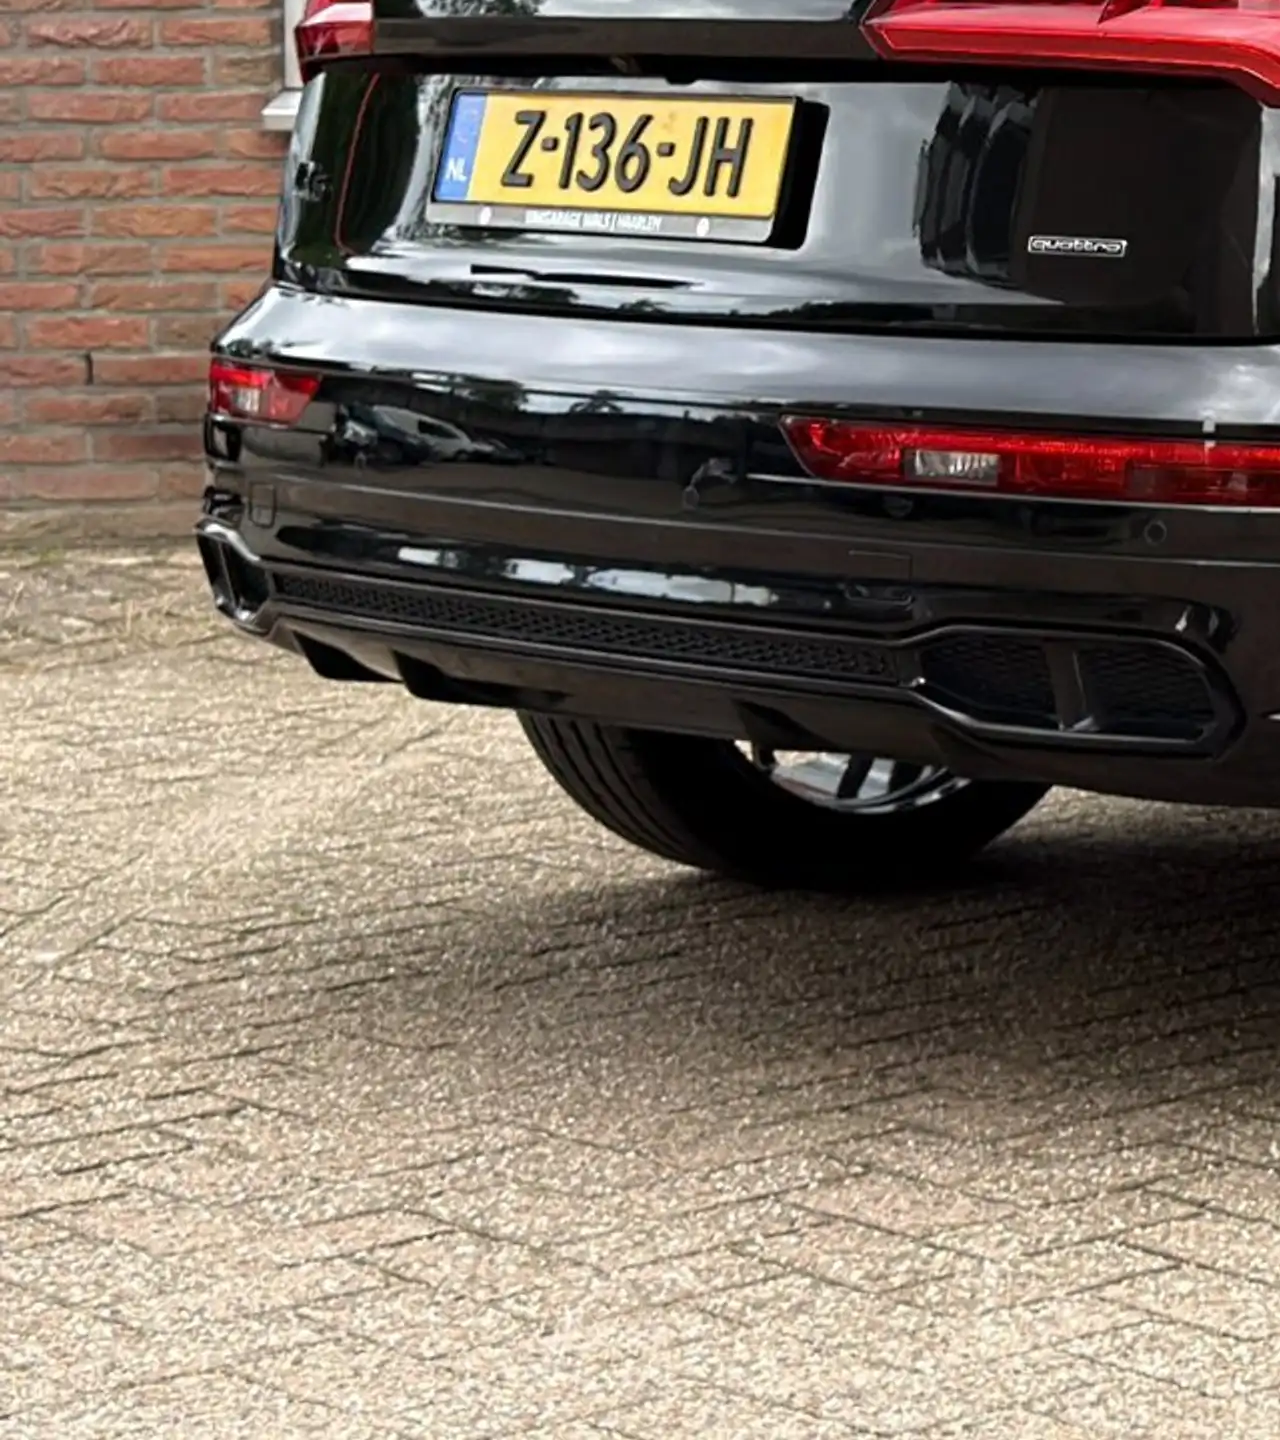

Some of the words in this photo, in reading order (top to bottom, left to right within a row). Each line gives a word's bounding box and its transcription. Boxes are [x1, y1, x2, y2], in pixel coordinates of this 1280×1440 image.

[501, 110, 754, 198] Z-136-JH
[445, 157, 467, 182] NL
[1031, 238, 1122, 253] quattro
